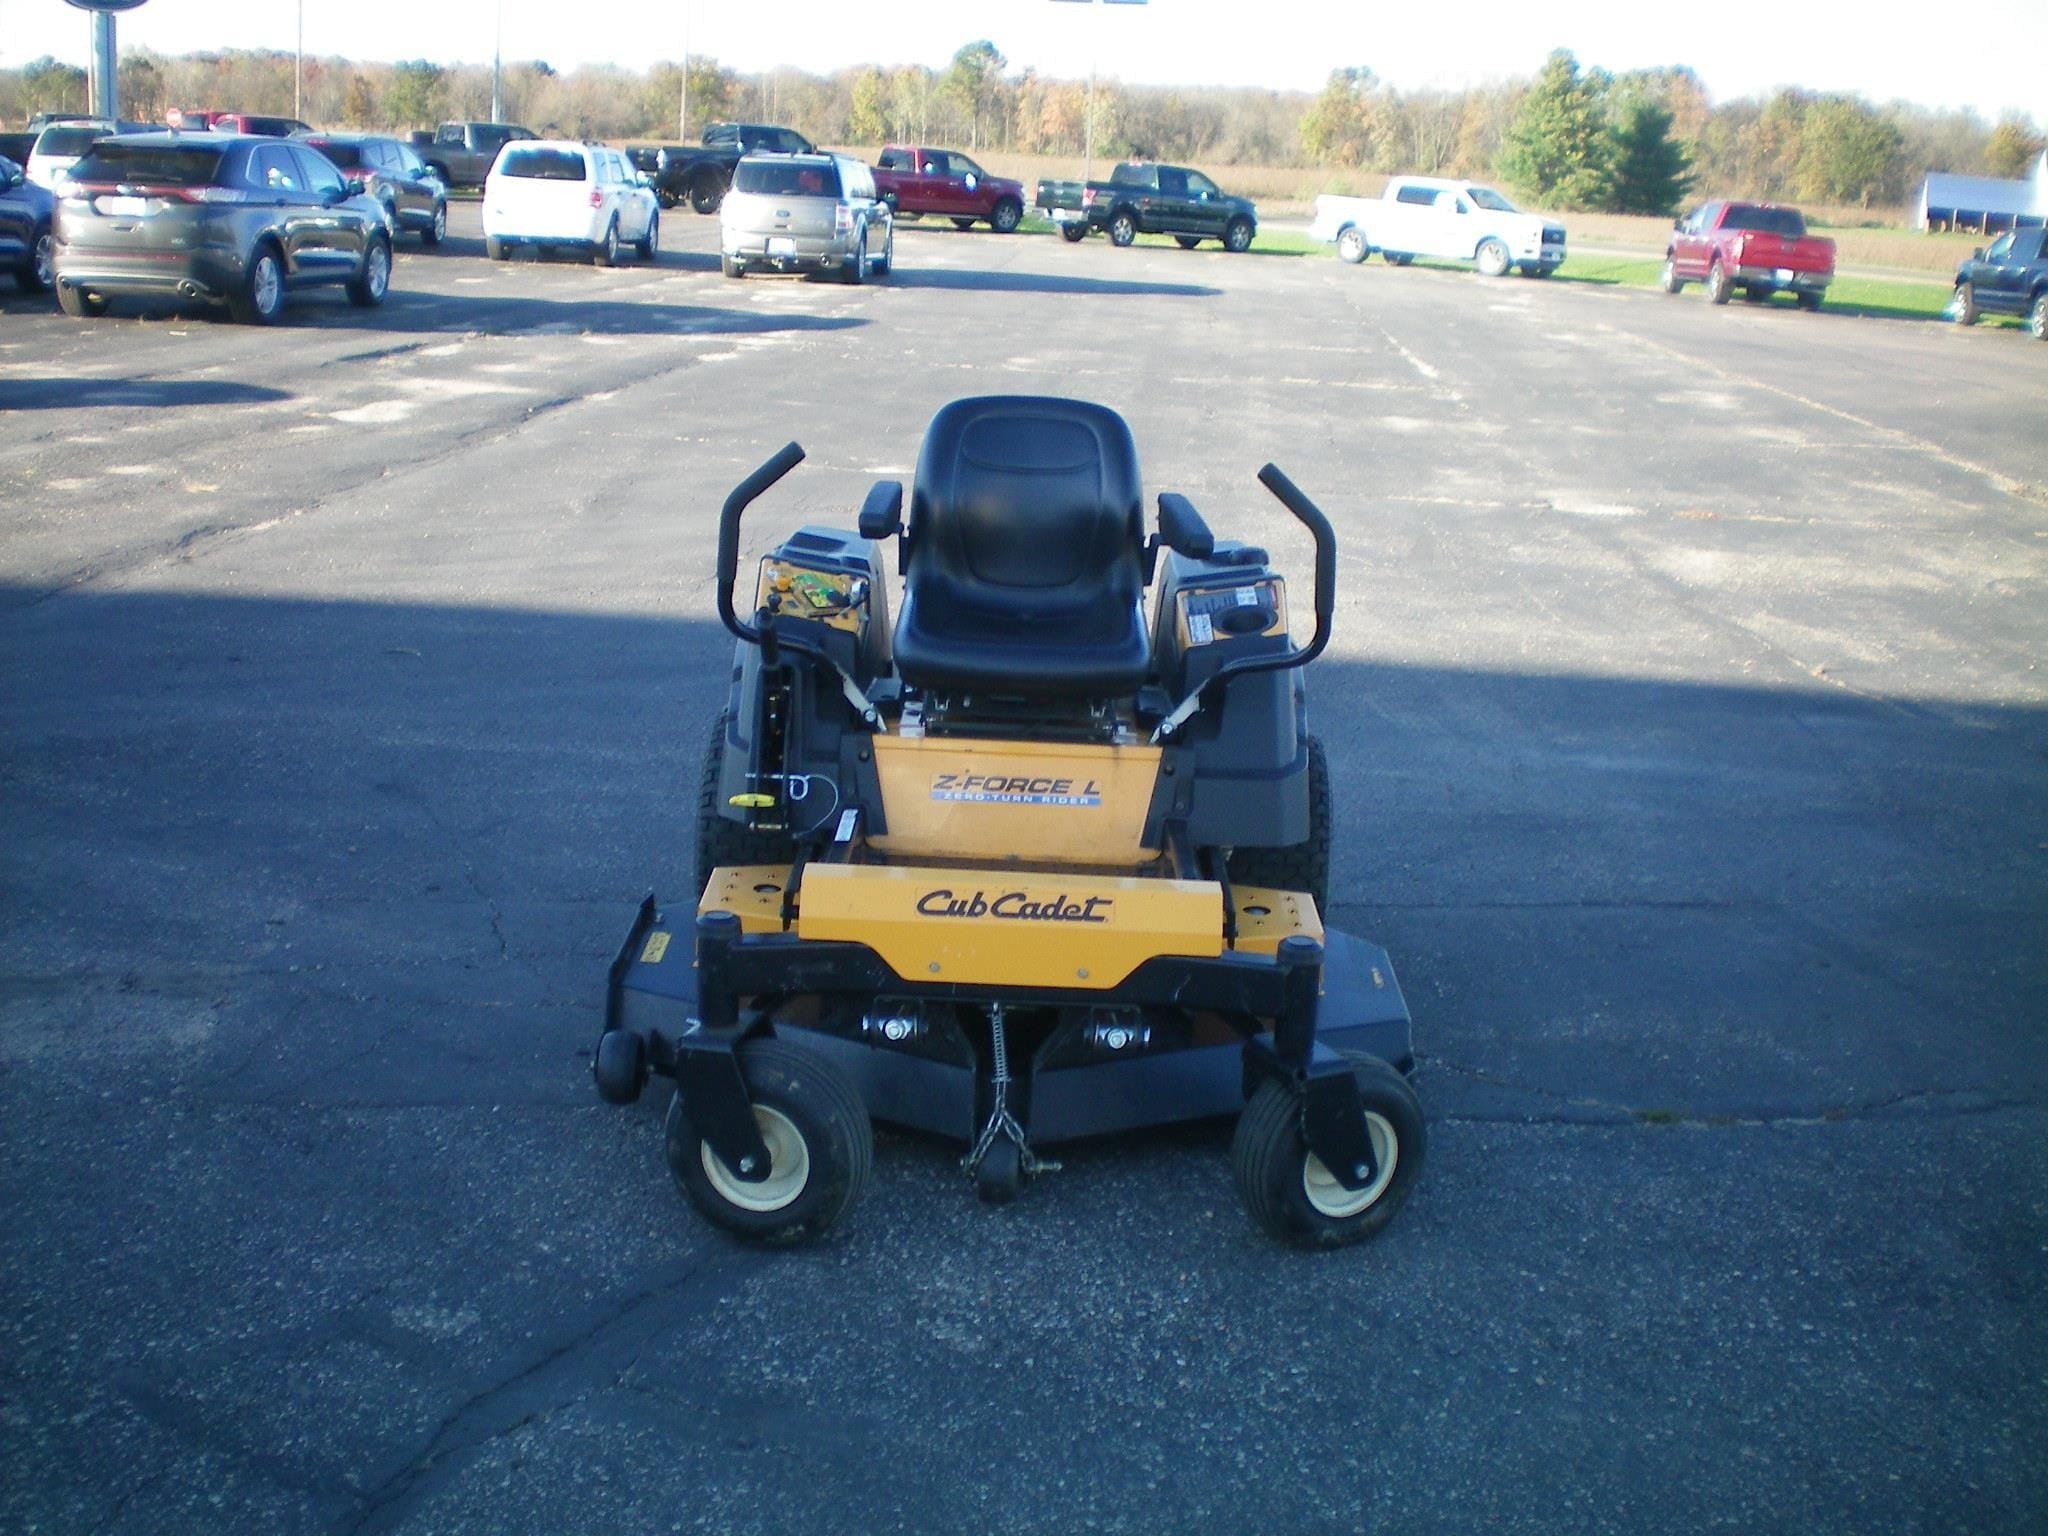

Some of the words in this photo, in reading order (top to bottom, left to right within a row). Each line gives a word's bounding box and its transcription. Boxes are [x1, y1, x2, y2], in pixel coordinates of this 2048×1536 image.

[932, 775, 1073, 794] Z-FORCE
[1083, 780, 1101, 795] L
[1041, 795, 1089, 805] RIDER
[916, 889, 988, 918] Cub
[990, 892, 1113, 923] Cadet
